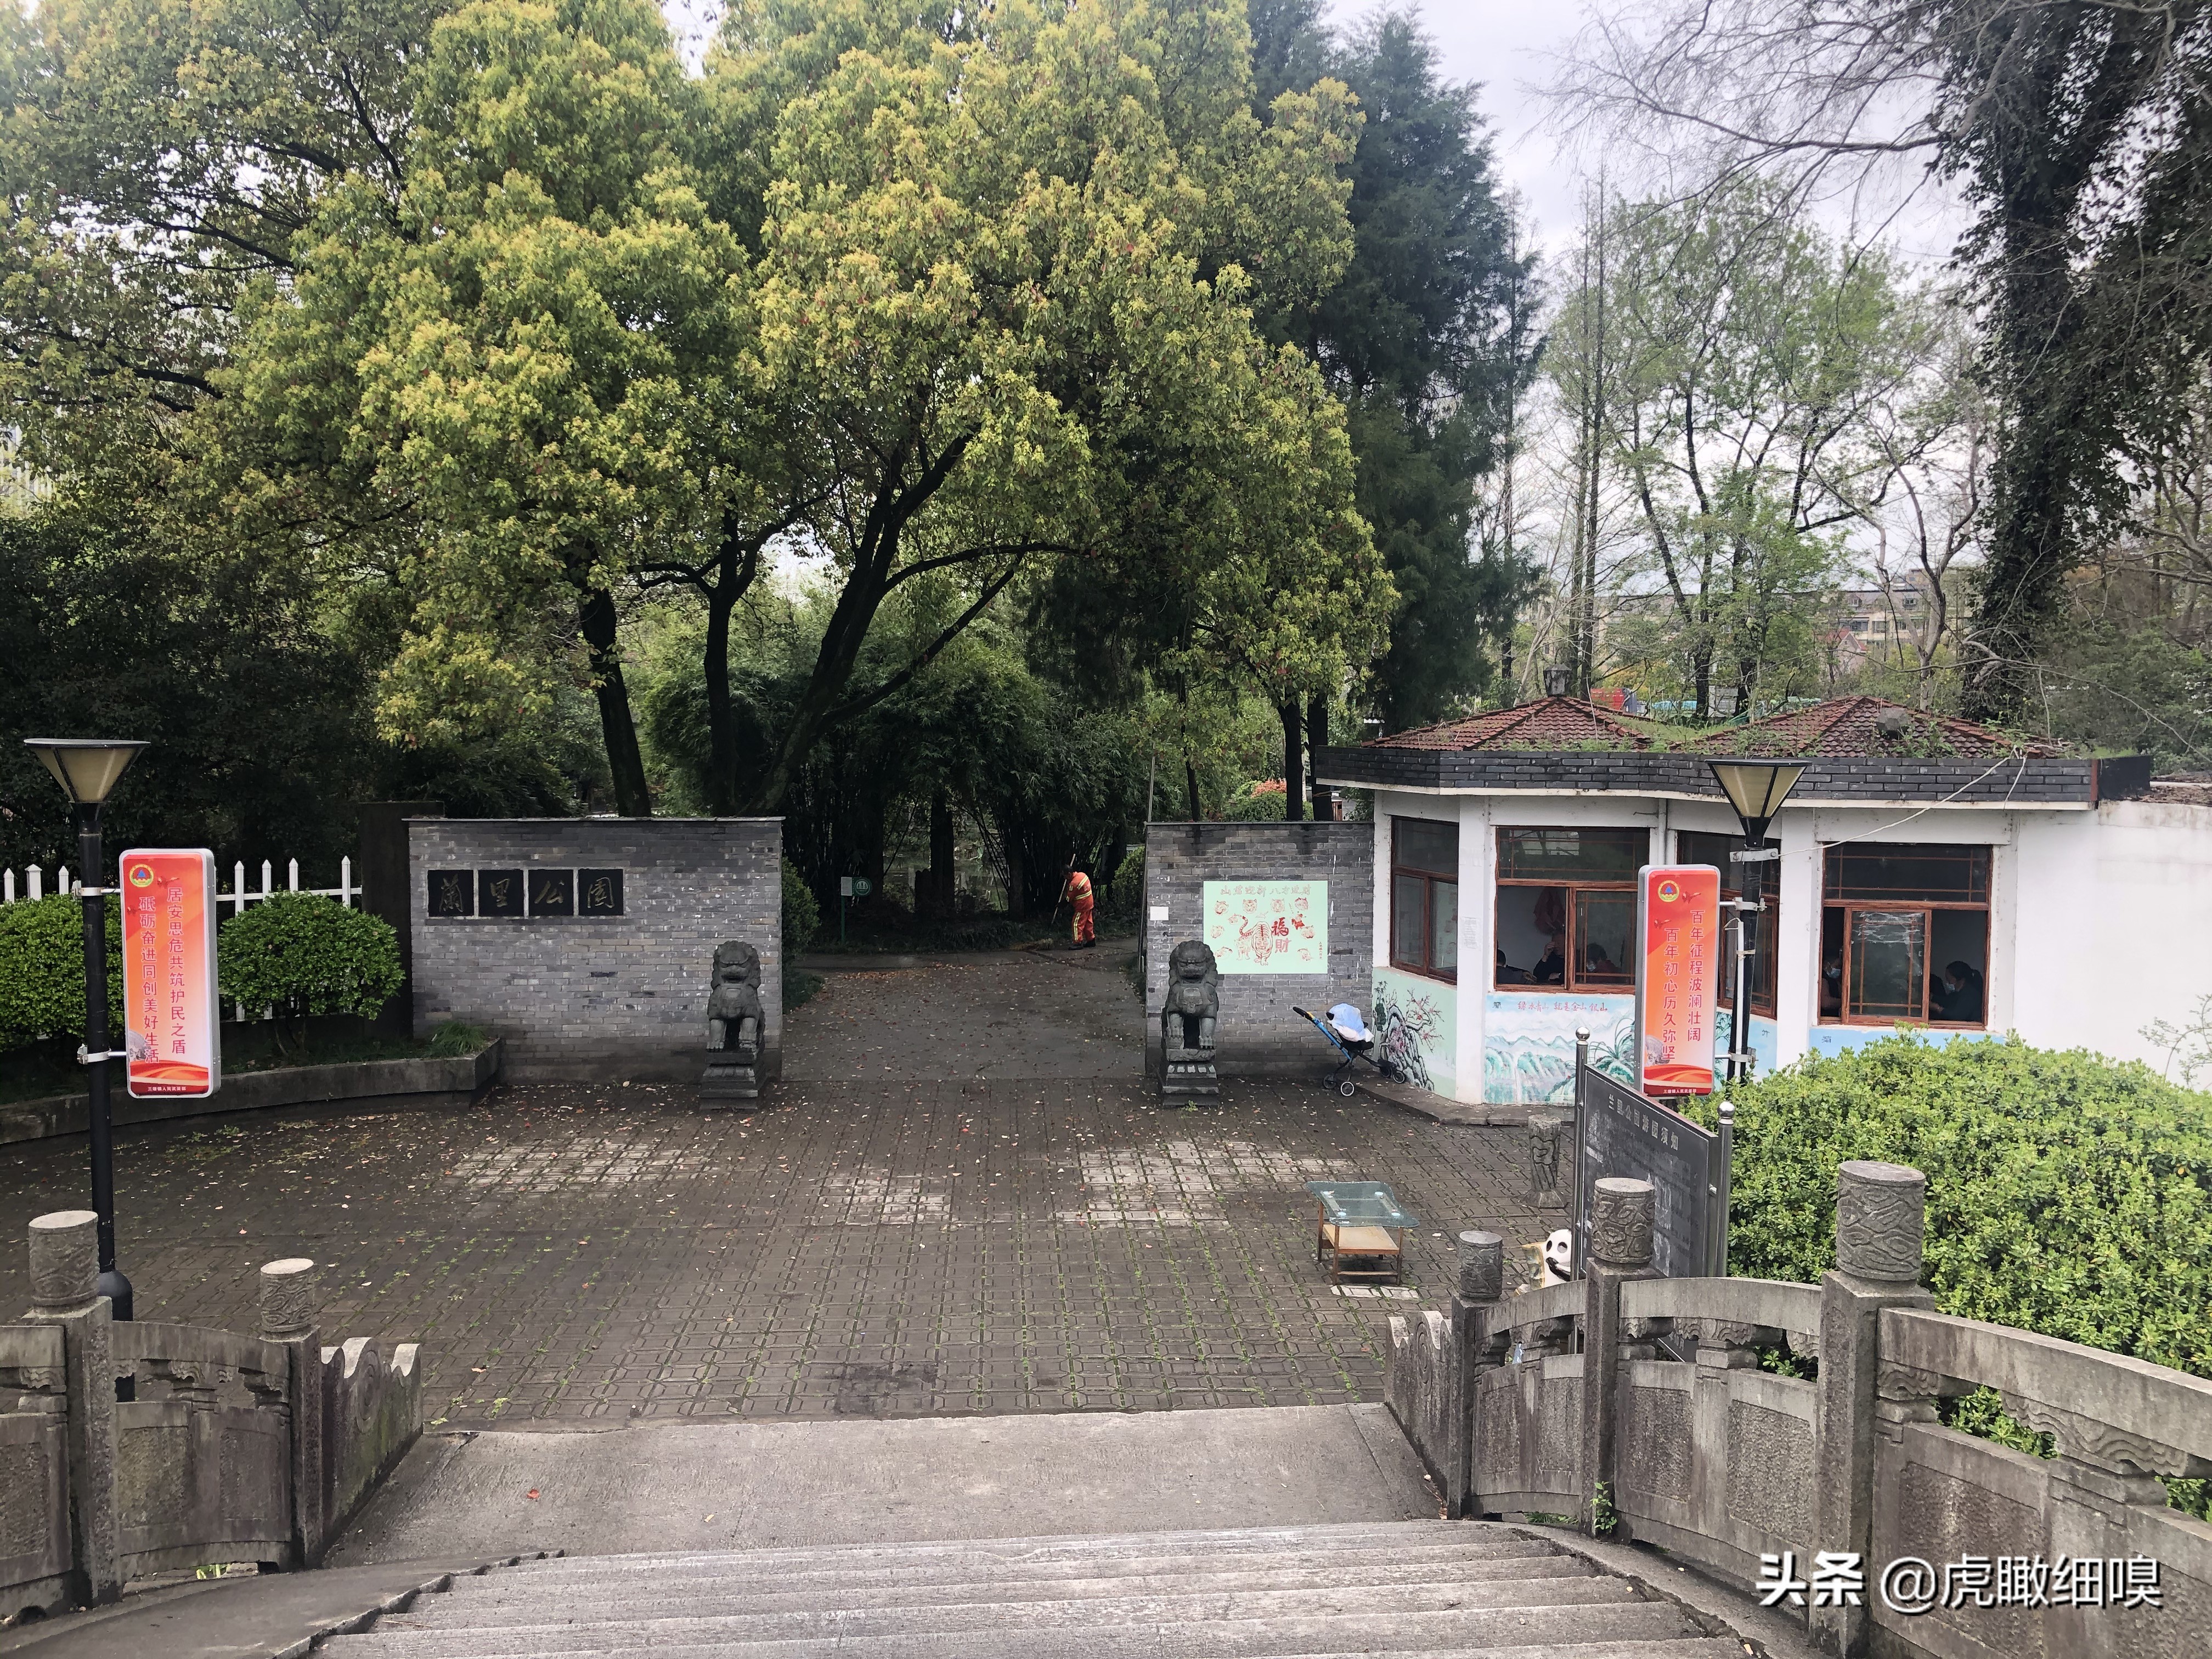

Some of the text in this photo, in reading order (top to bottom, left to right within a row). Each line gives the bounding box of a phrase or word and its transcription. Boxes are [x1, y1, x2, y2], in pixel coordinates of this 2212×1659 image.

[139, 896, 159, 1063] 砥砺奋进同创美好生活
[167, 887, 186, 1054] 居安思危共筑护民之盾
[1662, 928, 1680, 1060] 百年初心历久弥坚
[1688, 910, 1705, 1042] 百年征程波澜壮阔
